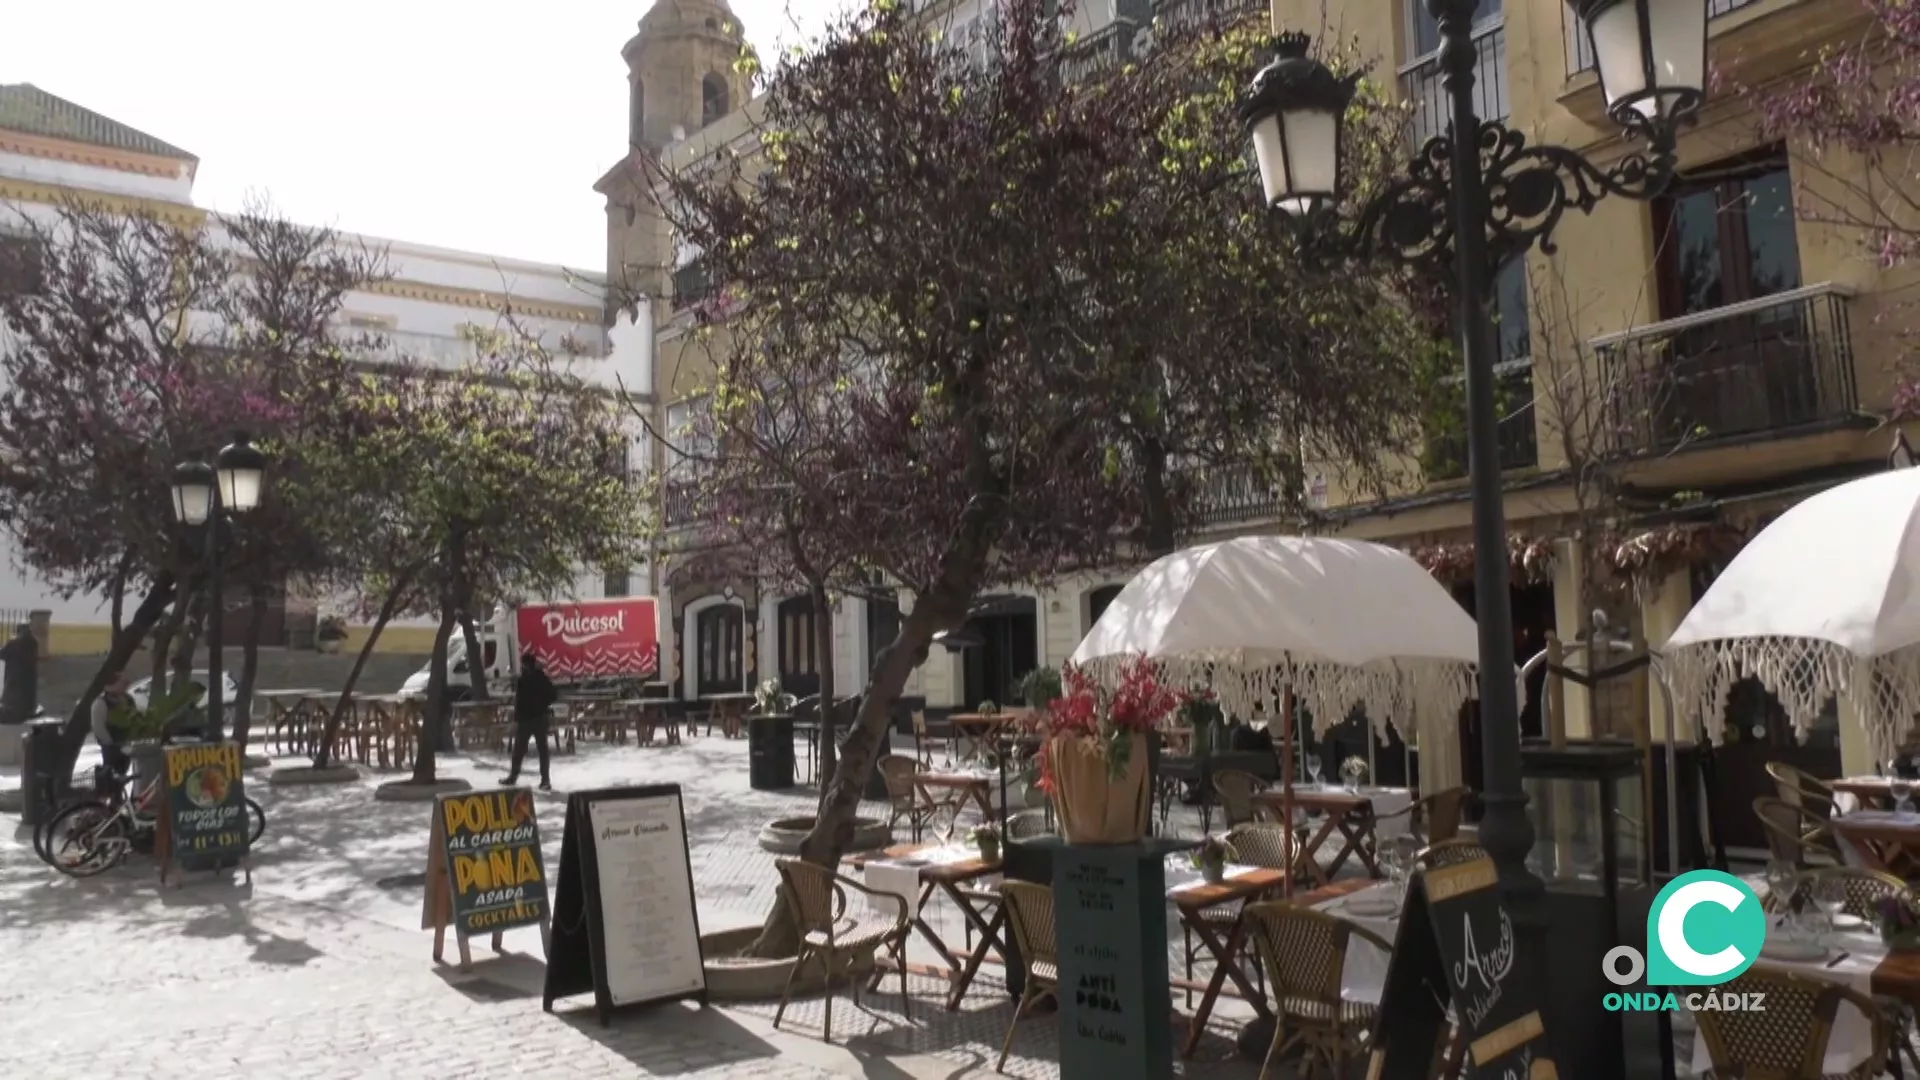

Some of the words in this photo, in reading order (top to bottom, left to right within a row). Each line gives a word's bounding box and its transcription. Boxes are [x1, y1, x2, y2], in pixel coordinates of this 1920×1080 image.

[542, 608, 624, 638] Dulcesol
[167, 744, 242, 788] BRUNCH
[448, 836, 466, 850] AL
[475, 886, 524, 905] ASADA
[467, 902, 540, 928] COCKTAILS
